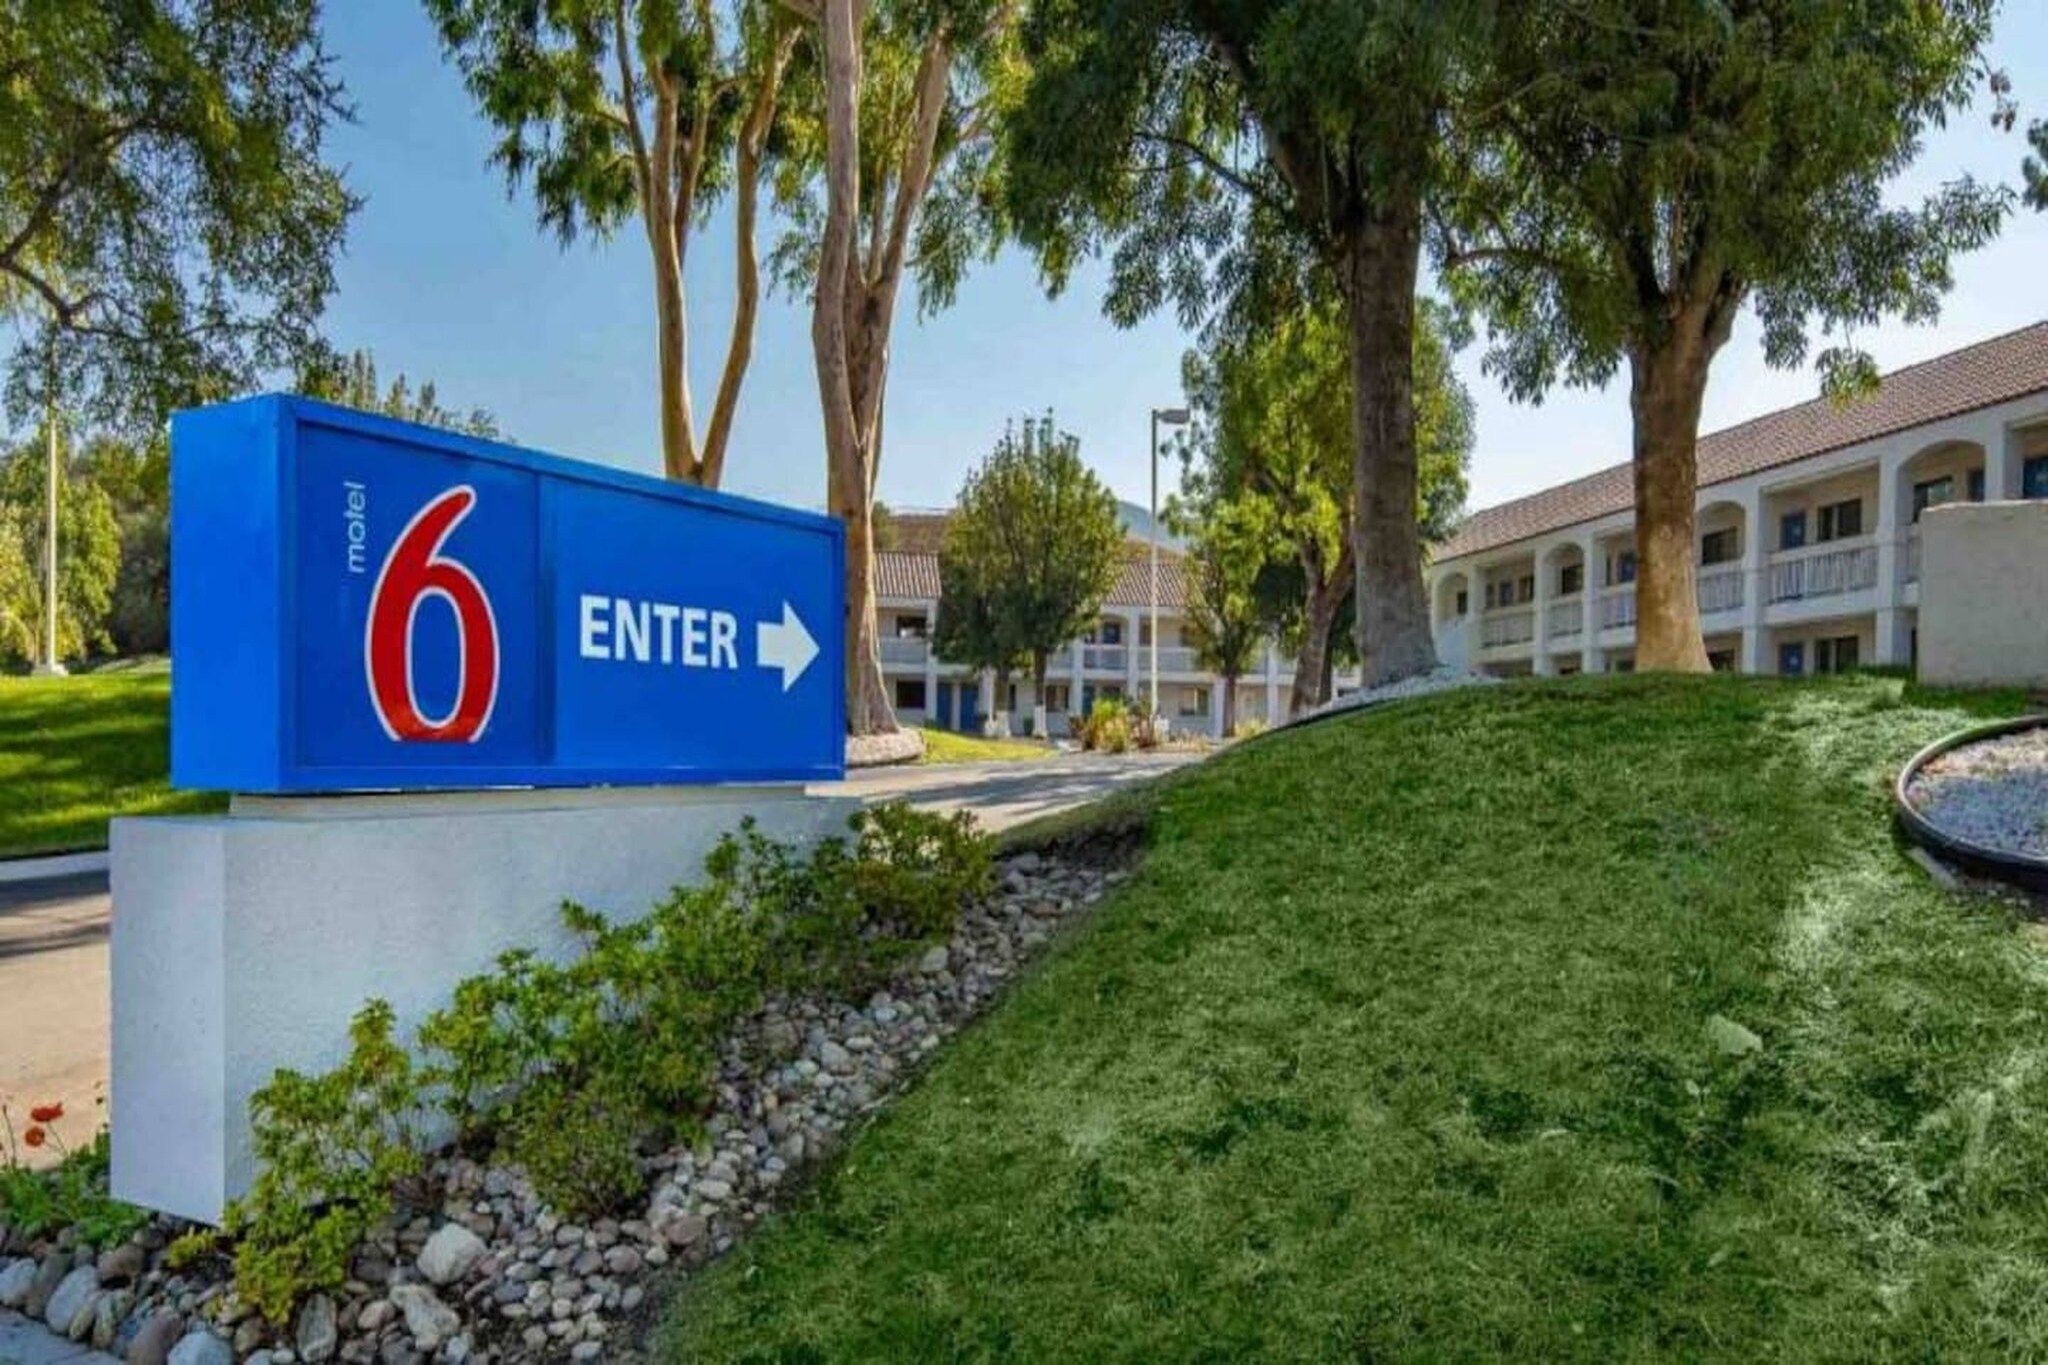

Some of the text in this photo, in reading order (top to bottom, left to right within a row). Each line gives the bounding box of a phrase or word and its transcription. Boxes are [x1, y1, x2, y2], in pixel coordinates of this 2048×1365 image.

[344, 481, 366, 573] motel
[365, 485, 500, 743] 6
[580, 595, 738, 669] ENTER
